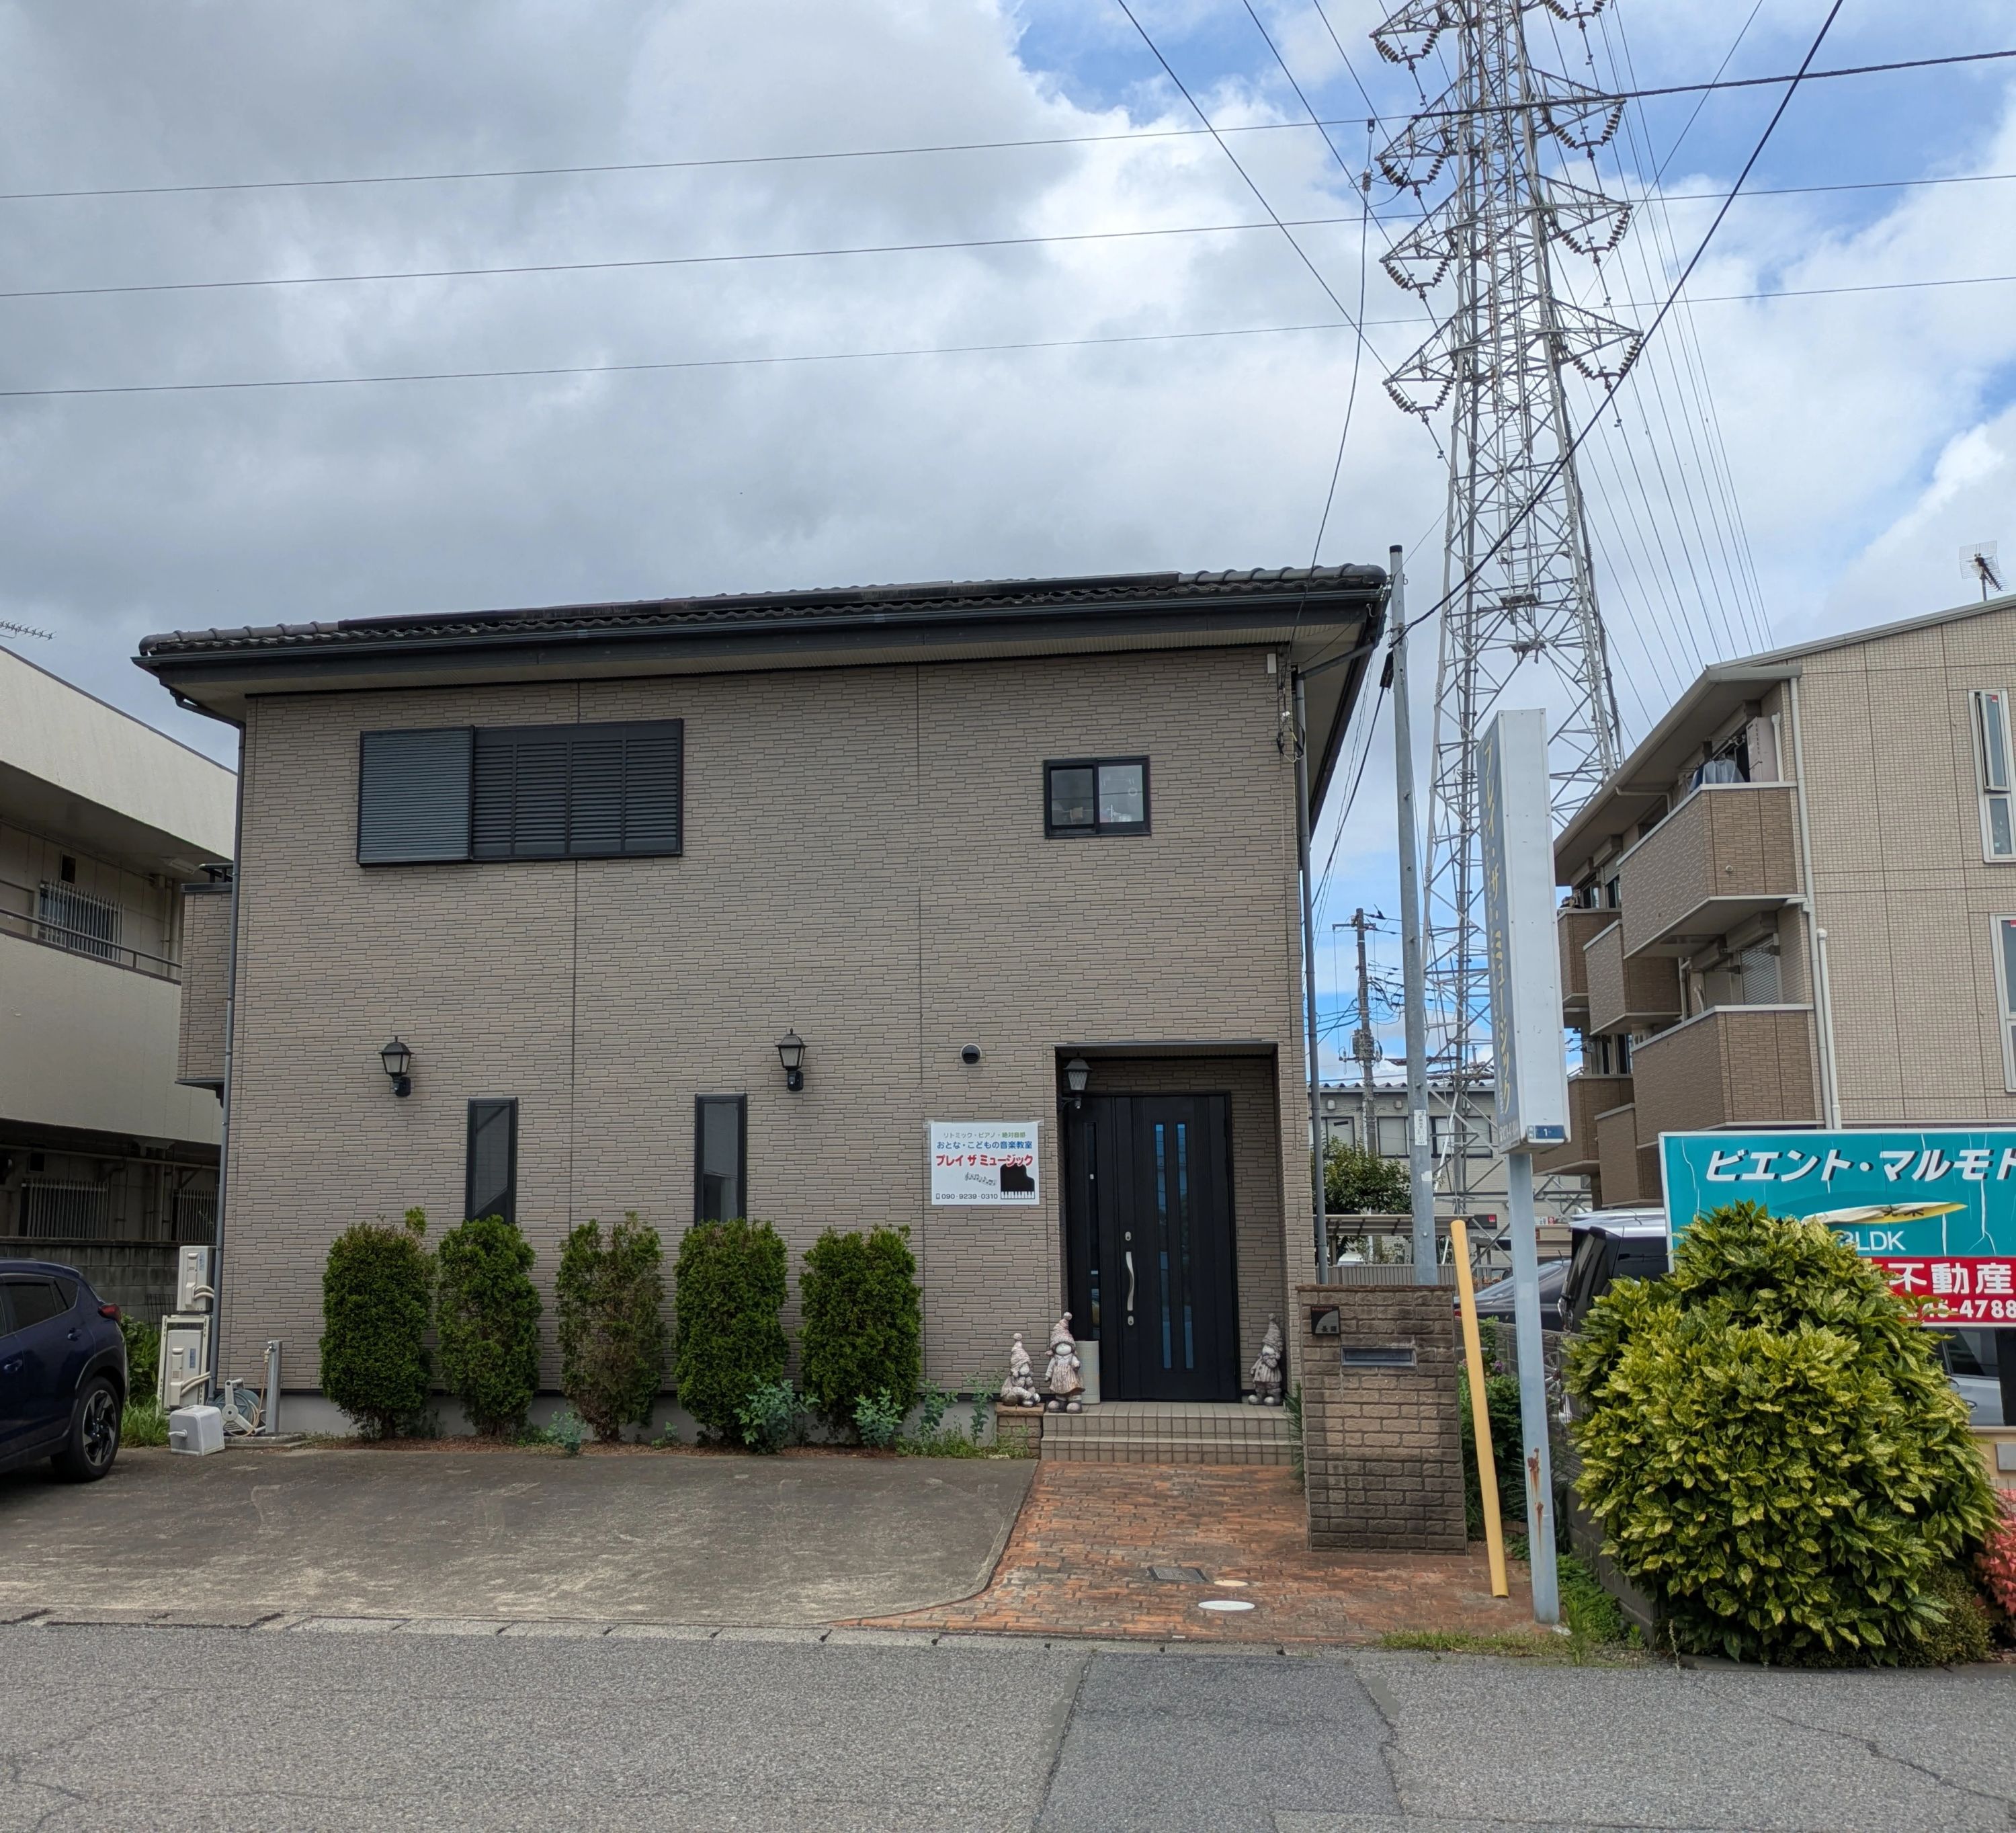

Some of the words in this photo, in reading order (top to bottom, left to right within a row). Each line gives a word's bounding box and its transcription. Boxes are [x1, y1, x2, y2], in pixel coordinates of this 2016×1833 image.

[937, 1141, 1032, 1149] おとな・こどもの音楽教室
[1888, 1262, 2014, 1295] 不動産
